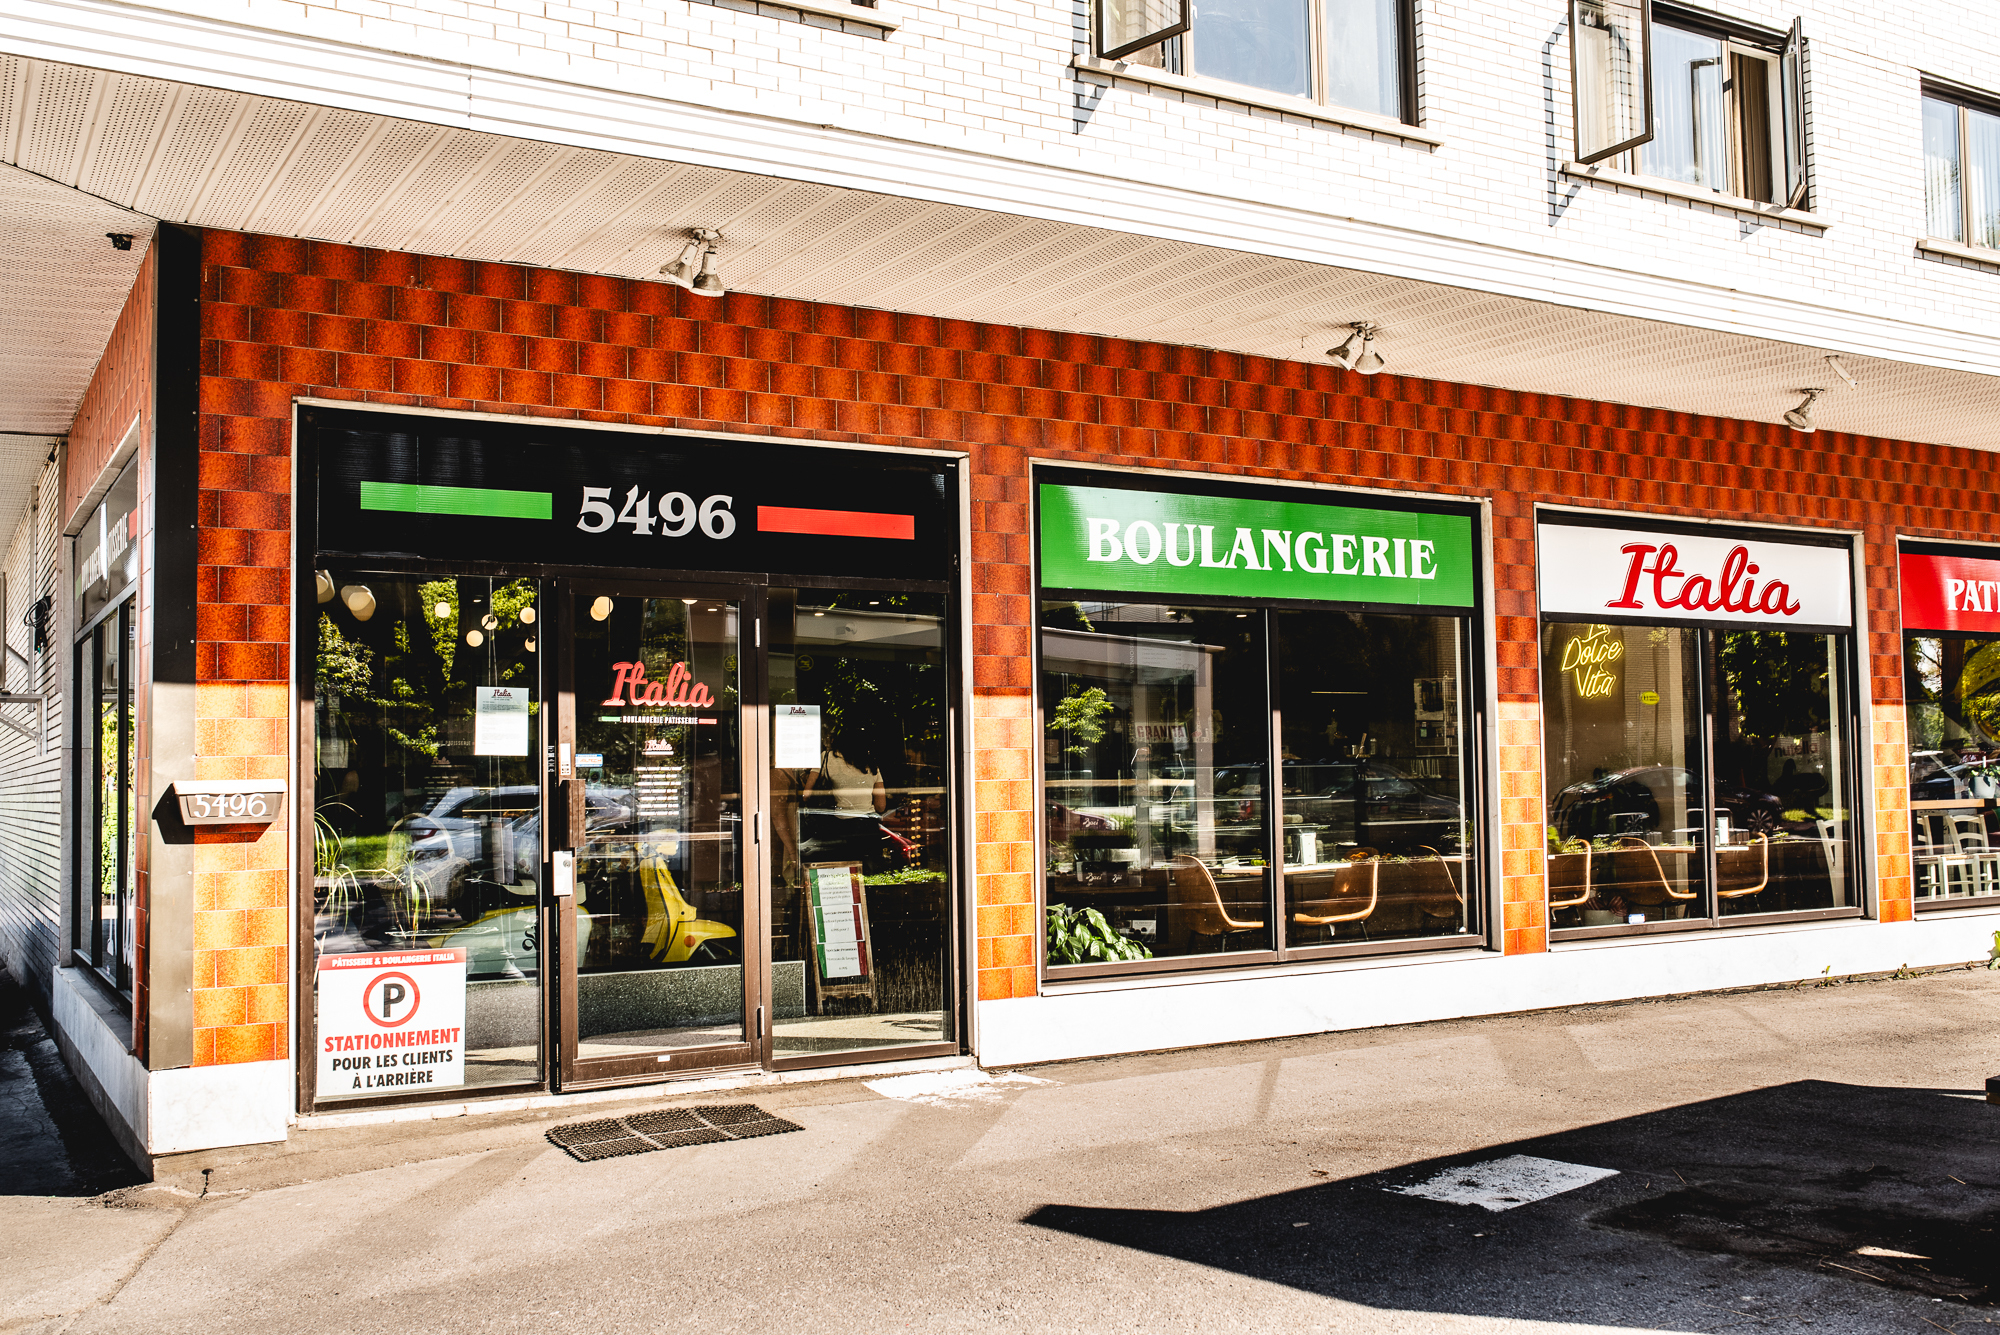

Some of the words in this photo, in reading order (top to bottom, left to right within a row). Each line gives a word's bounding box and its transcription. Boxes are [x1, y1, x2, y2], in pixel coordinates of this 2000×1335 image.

[576, 484, 737, 540] 5496
[1086, 517, 1438, 580] BOULANGERIE
[1604, 541, 1800, 616] Italia
[1561, 637, 1622, 672] Dolce
[602, 661, 715, 708] Italia
[1576, 665, 1614, 697] Vita
[622, 715, 663, 724] BOULANGERIE
[664, 716, 698, 725] PATISSERIE
[1137, 725, 1185, 740] GRANITA
[1774, 740, 1818, 758] nutella
[193, 793, 267, 818] 5496
[332, 957, 373, 968] PÂTISSERIE
[374, 957, 381, 966] &
[382, 954, 431, 965] BOULANGERIE
[433, 953, 455, 962] ITALIA
[383, 983, 406, 1018] P
[324, 1027, 460, 1053] STATIONNEMENT
[332, 1056, 371, 1071] POUR
[376, 1054, 398, 1068] LES
[402, 1049, 453, 1066] CLIENTS
[352, 1072, 362, 1089] À
[366, 1068, 433, 1088] L'ARRIÈRE
